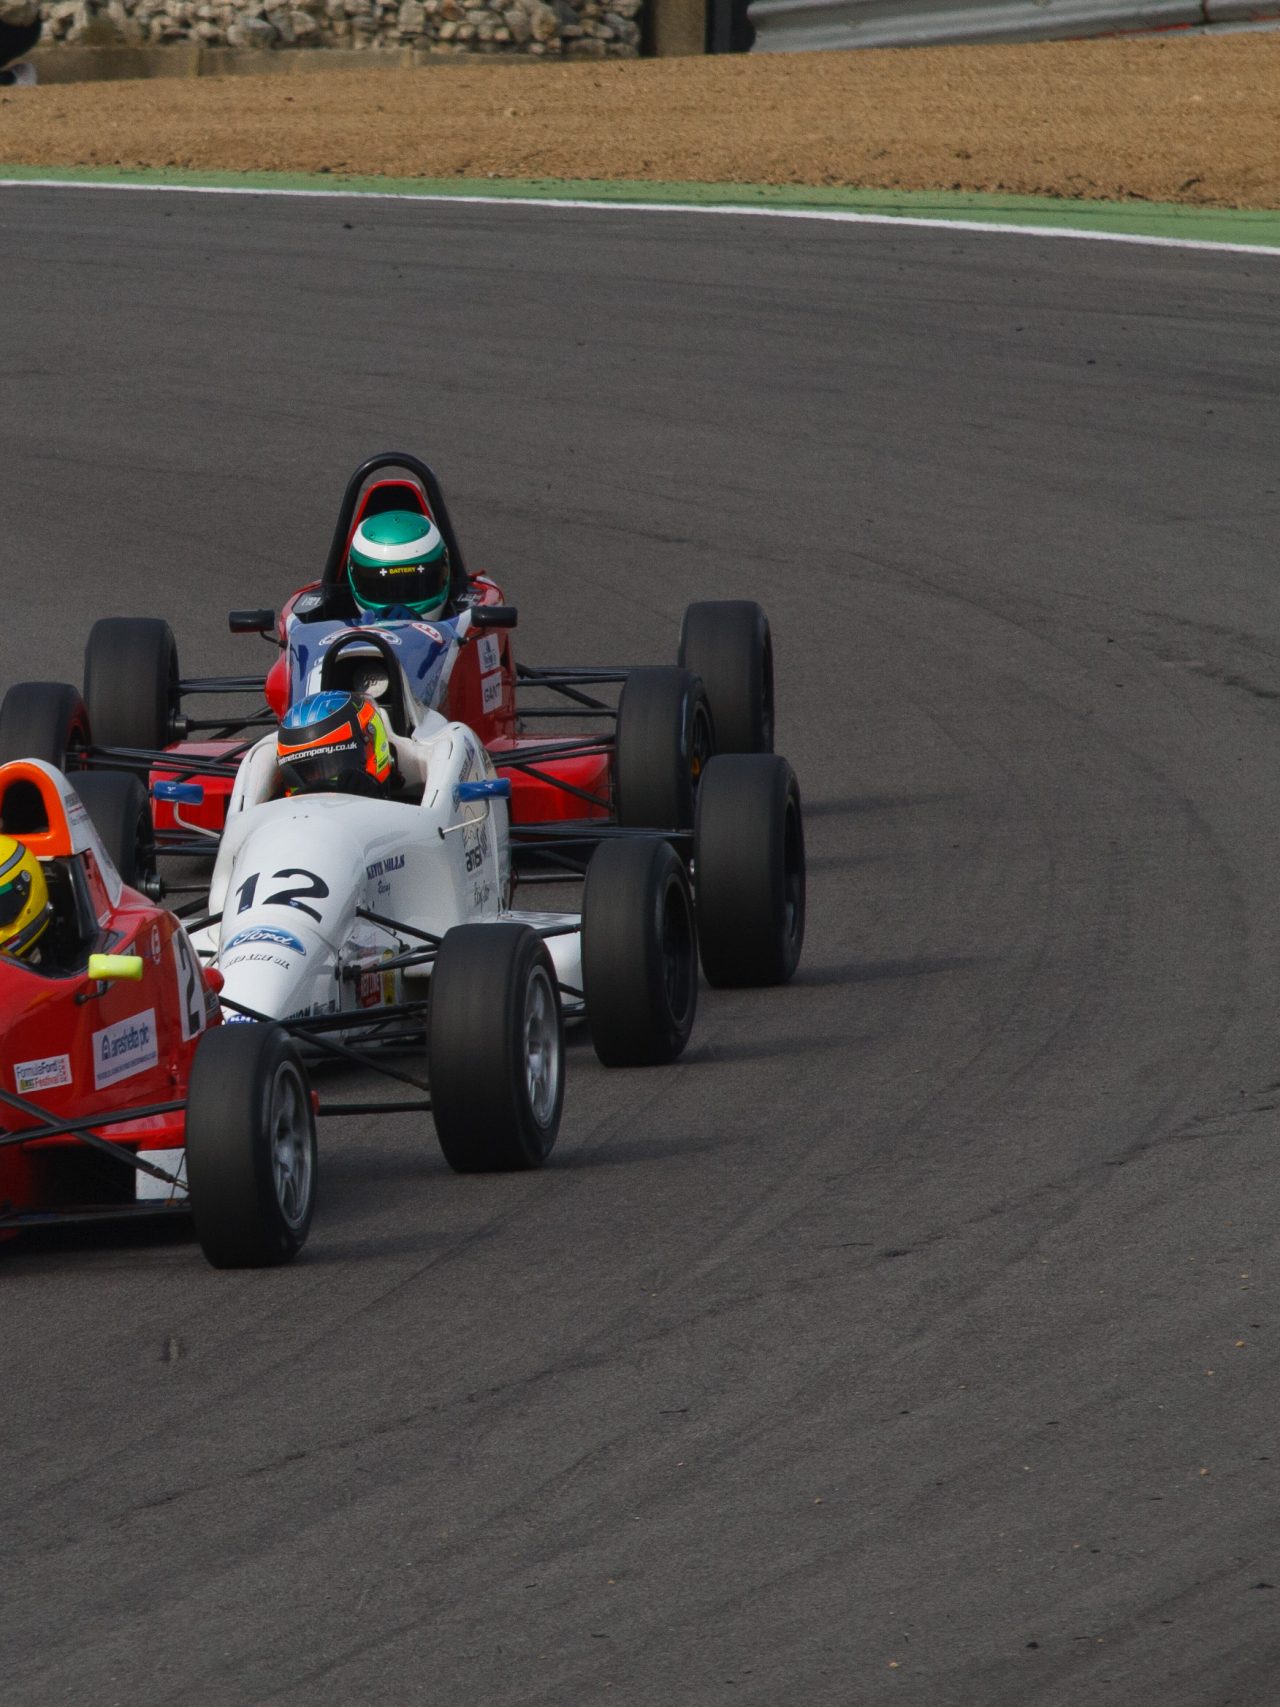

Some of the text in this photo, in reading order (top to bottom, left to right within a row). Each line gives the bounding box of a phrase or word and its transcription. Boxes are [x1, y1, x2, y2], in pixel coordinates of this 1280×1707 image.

[389, 567, 416, 575] BATTERY
[235, 868, 330, 924] 12
[233, 928, 293, 947] Ford
[177, 929, 201, 1036] 2
